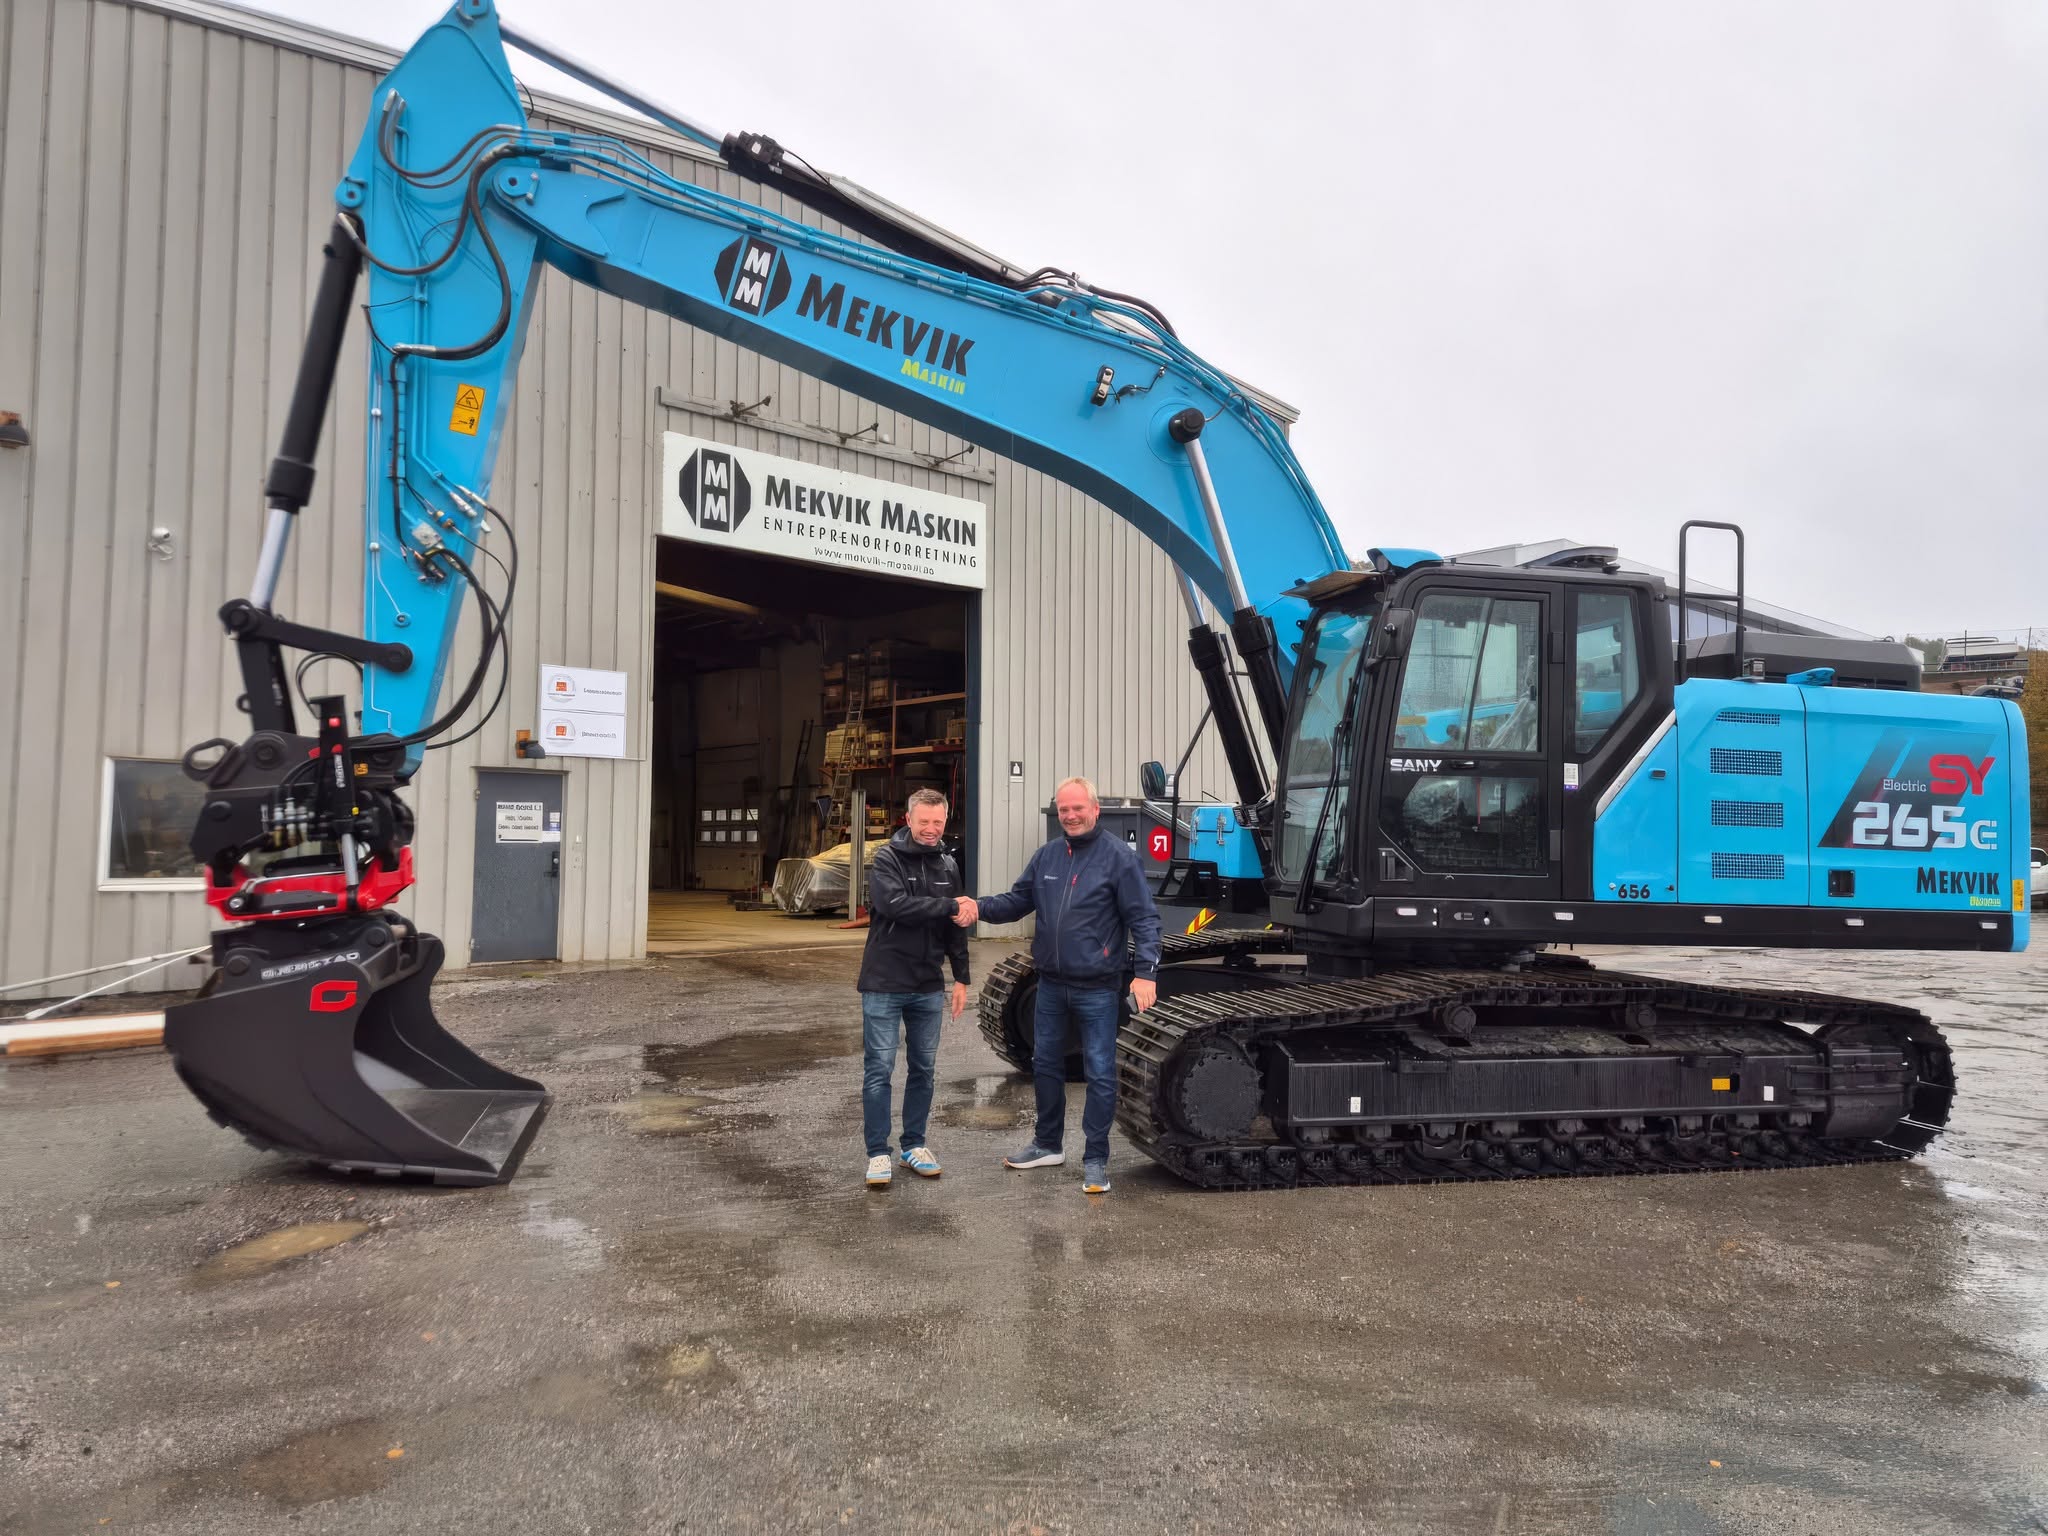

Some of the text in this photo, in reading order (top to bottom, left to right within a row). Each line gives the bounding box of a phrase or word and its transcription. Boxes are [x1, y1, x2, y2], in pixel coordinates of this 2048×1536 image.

[795, 273, 976, 377] MEKVIK
[765, 475, 977, 547] MEKVIK MASKIN
[1390, 758, 1442, 772] SANY
[1929, 754, 1996, 796] SY
[1883, 778, 1927, 792] Electric
[1618, 884, 1650, 899] 656
[1916, 866, 2000, 895] MEKVIK
